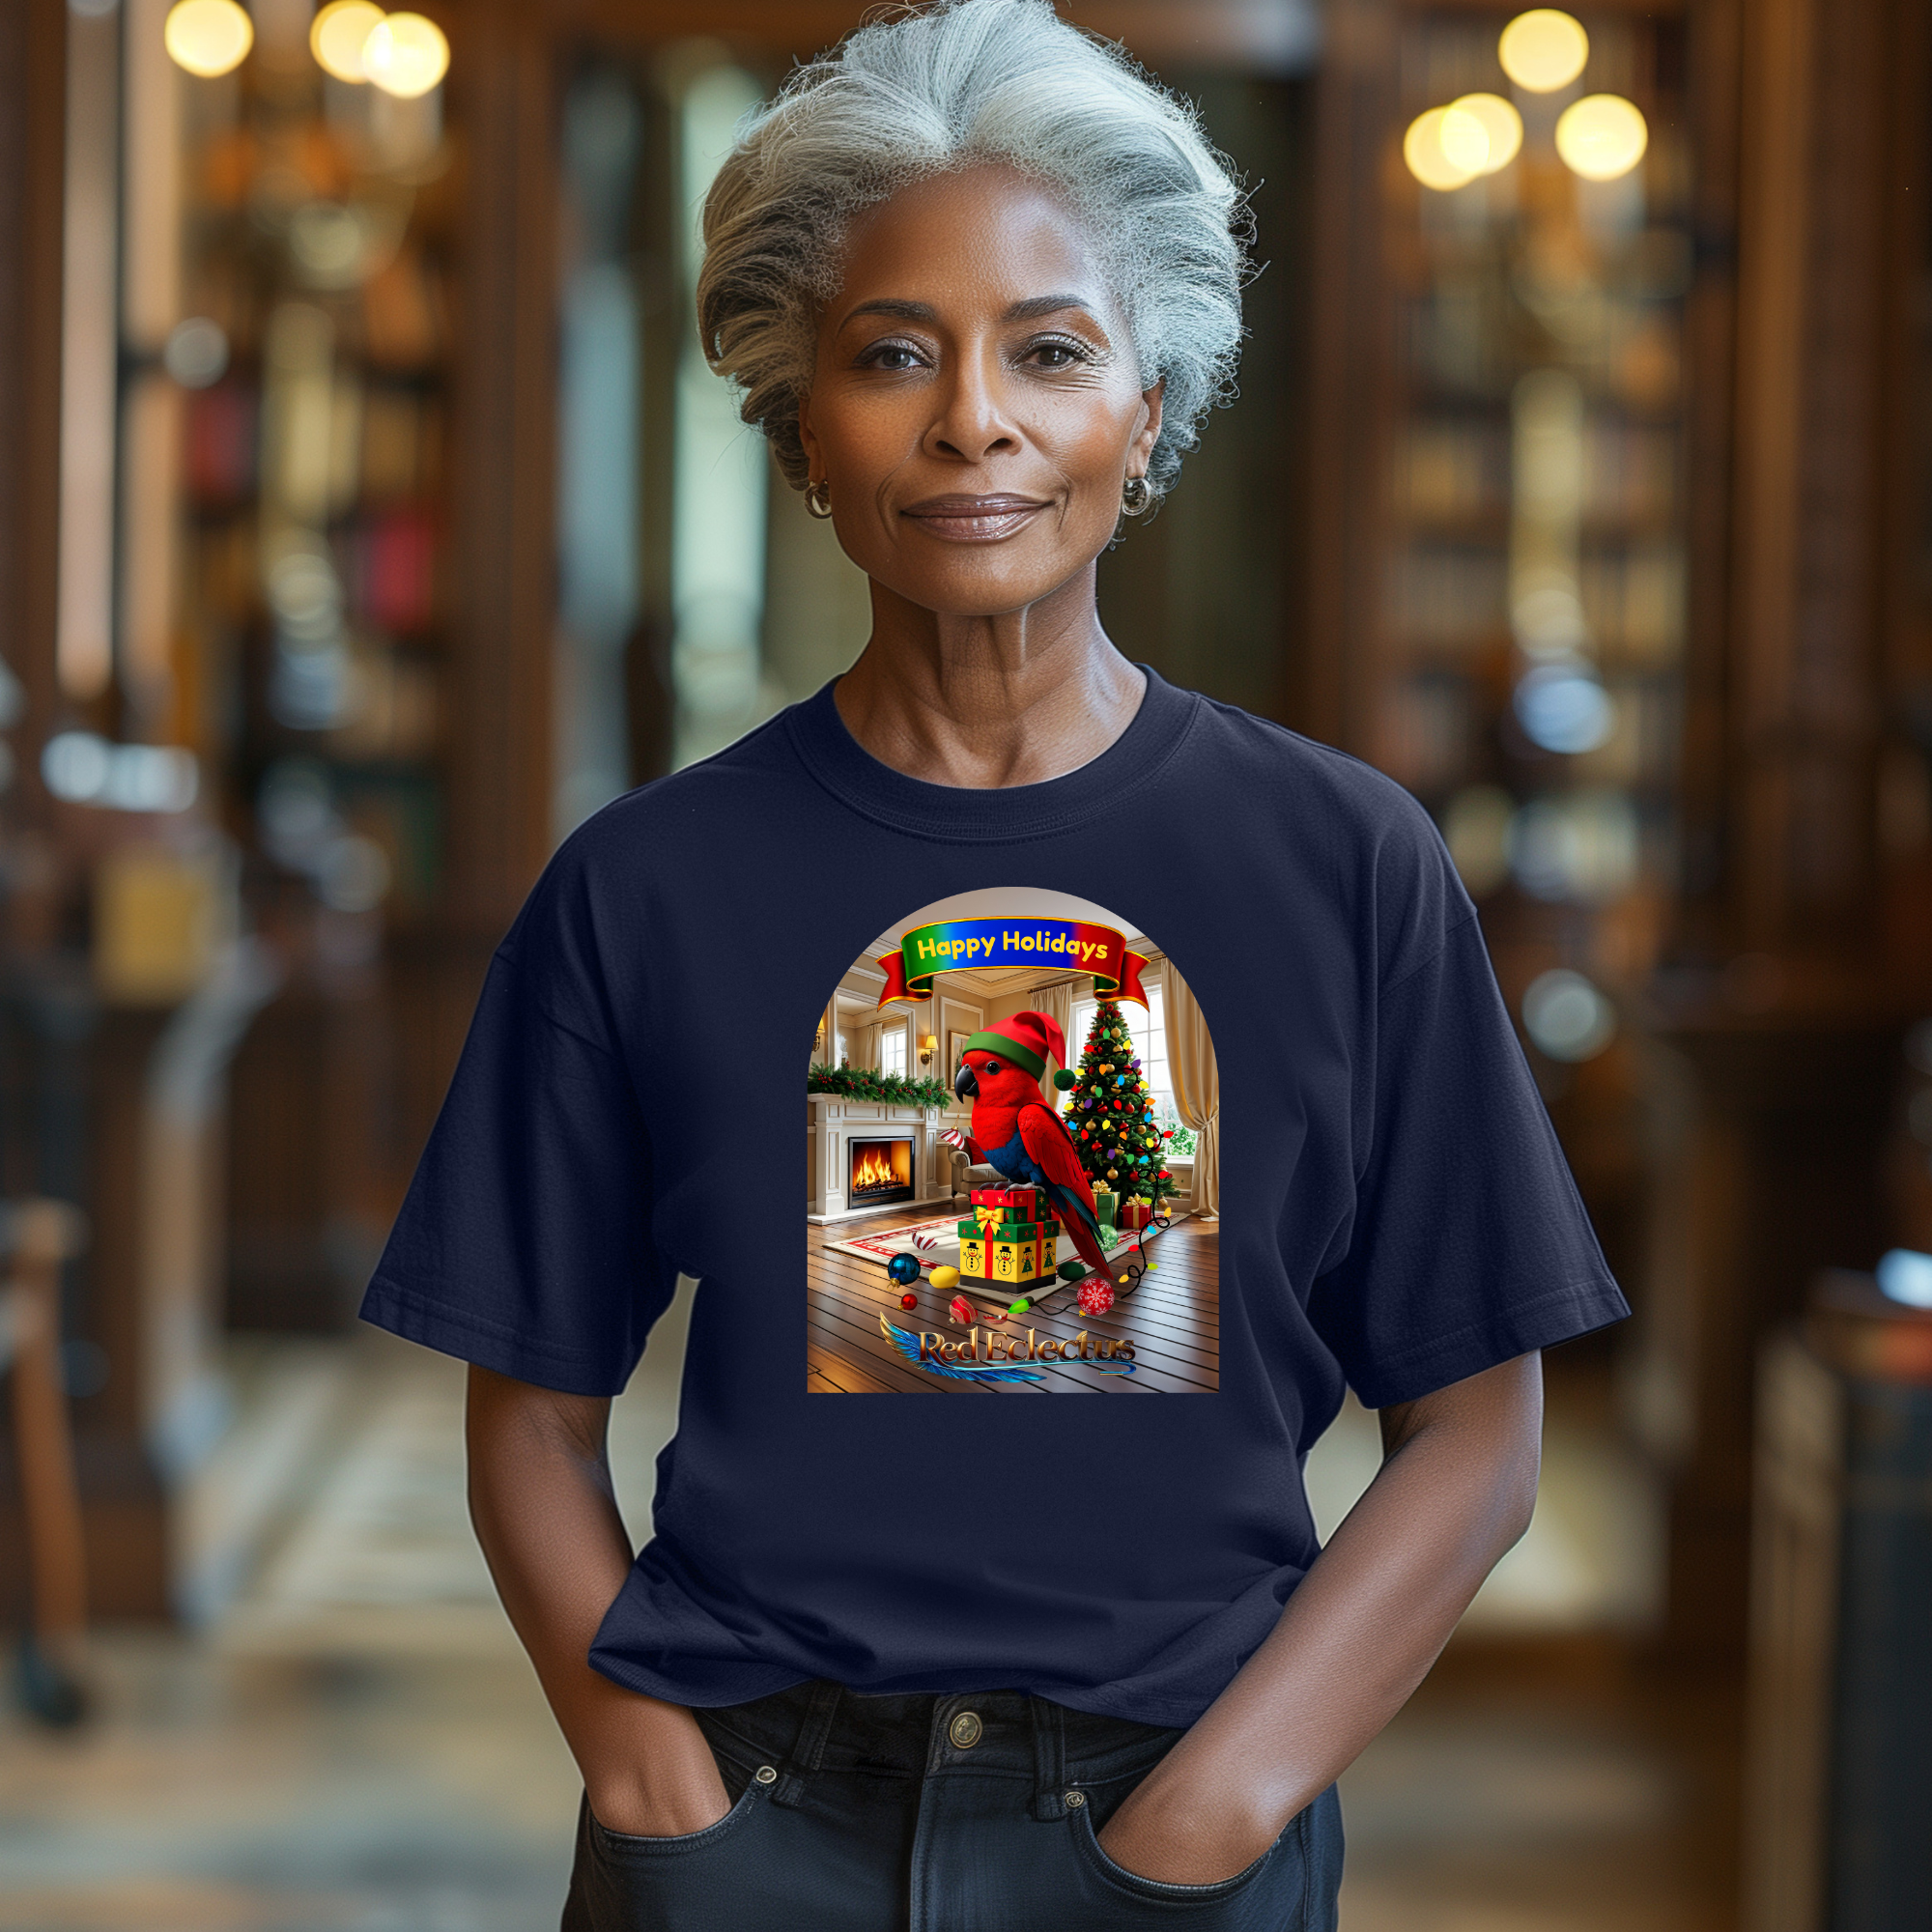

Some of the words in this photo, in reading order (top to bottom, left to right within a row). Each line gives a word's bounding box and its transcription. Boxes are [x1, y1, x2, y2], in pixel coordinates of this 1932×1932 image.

[918, 936, 995, 960] Happy
[1003, 931, 1108, 961] Holidays
[918, 1325, 980, 1368] Red
[982, 1327, 1136, 1362] Eclectus
